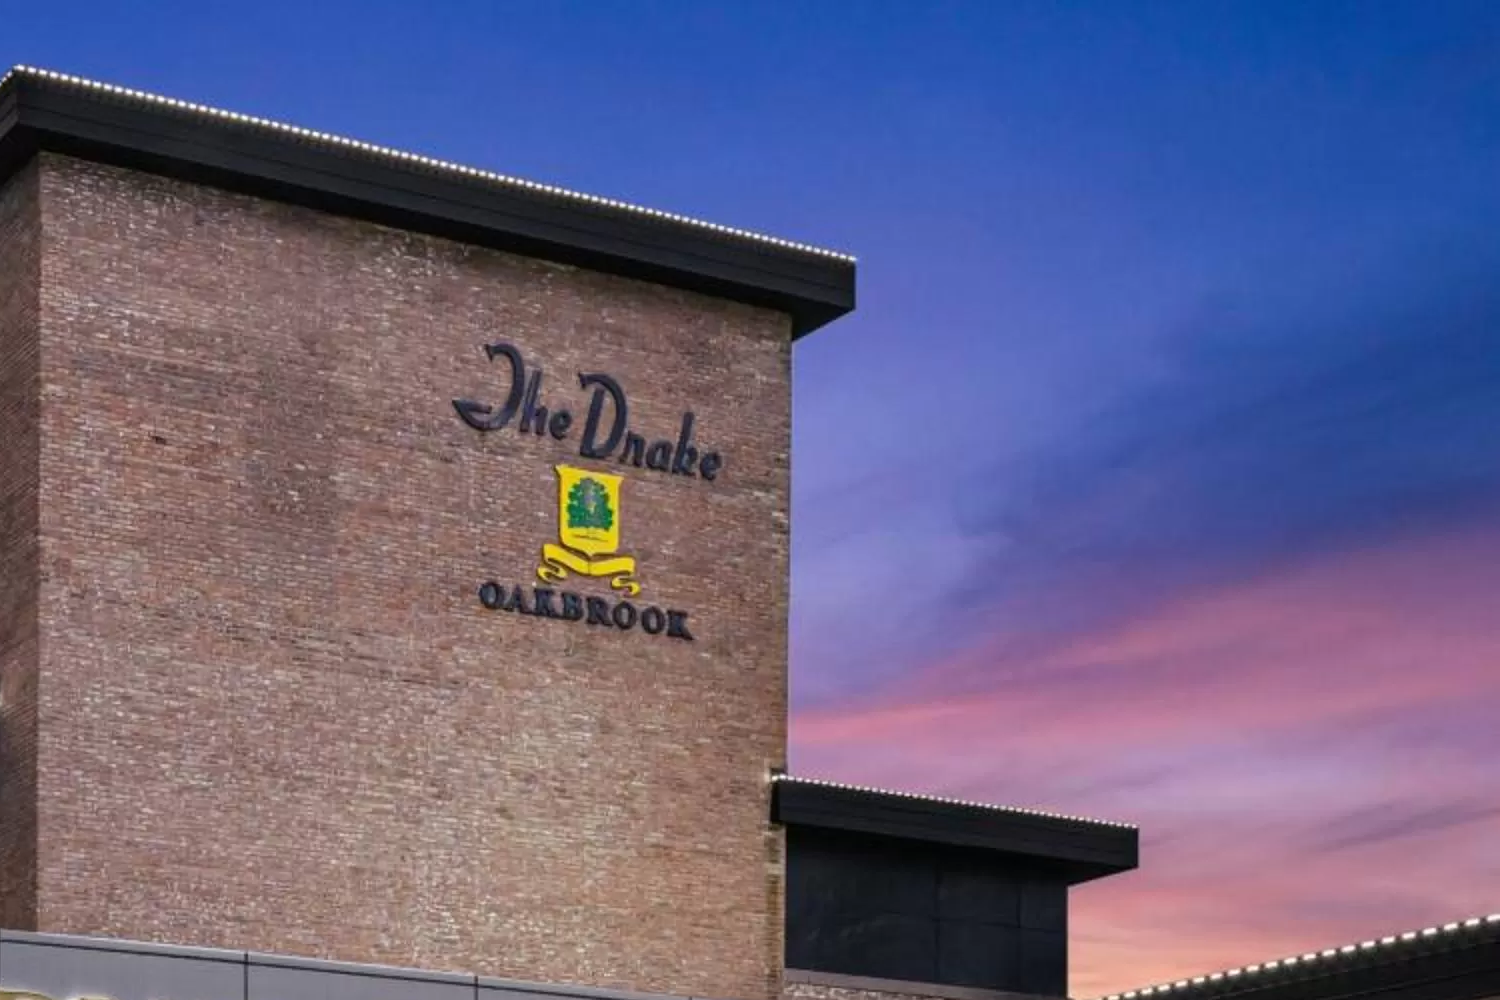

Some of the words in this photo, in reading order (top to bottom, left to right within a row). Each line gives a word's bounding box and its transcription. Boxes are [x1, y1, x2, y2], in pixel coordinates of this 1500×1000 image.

[452, 343, 573, 440] The
[579, 373, 722, 481] Drake
[479, 582, 694, 641] OAKBROOK
